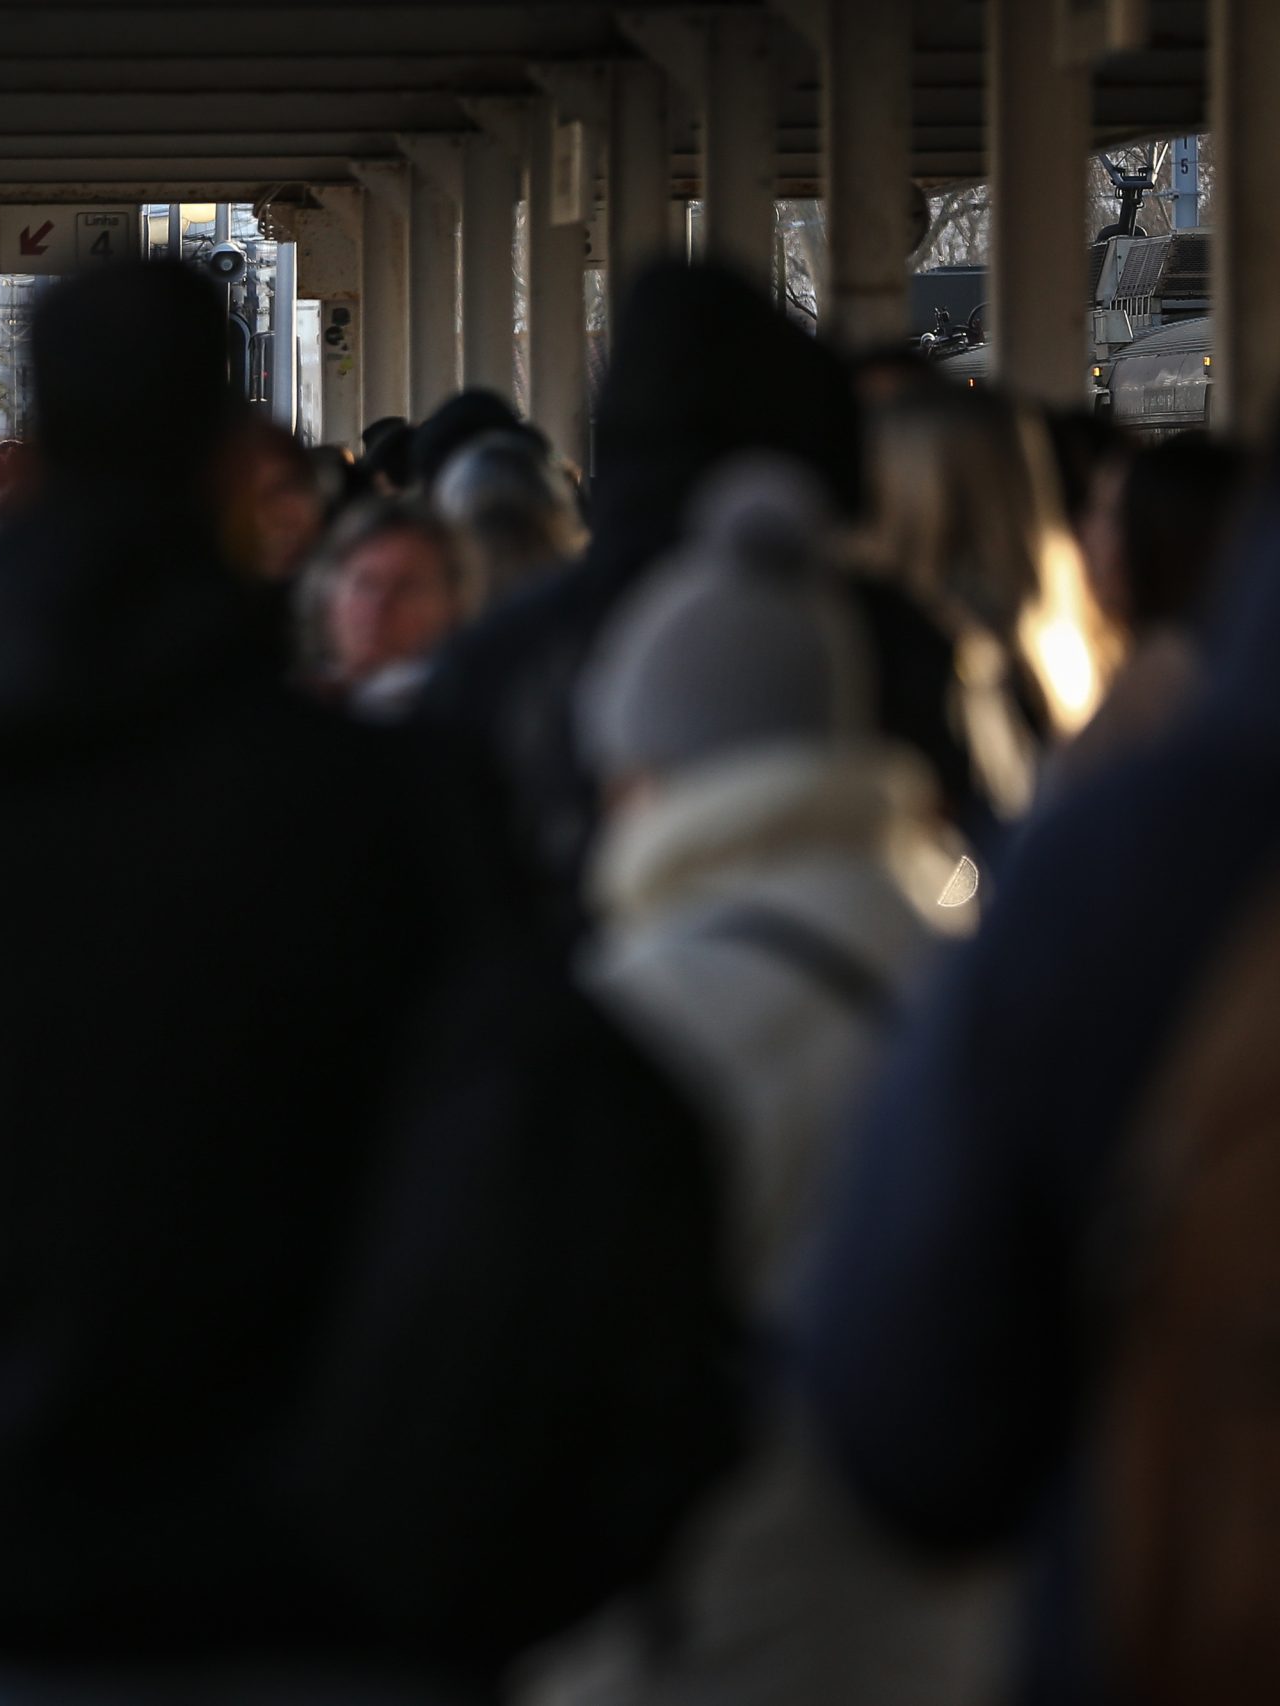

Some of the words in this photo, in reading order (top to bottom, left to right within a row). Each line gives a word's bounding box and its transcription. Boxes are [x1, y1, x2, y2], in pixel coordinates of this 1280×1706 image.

[1180, 158, 1189, 175] 5
[85, 214, 120, 226] Linha
[90, 230, 114, 258] 4
